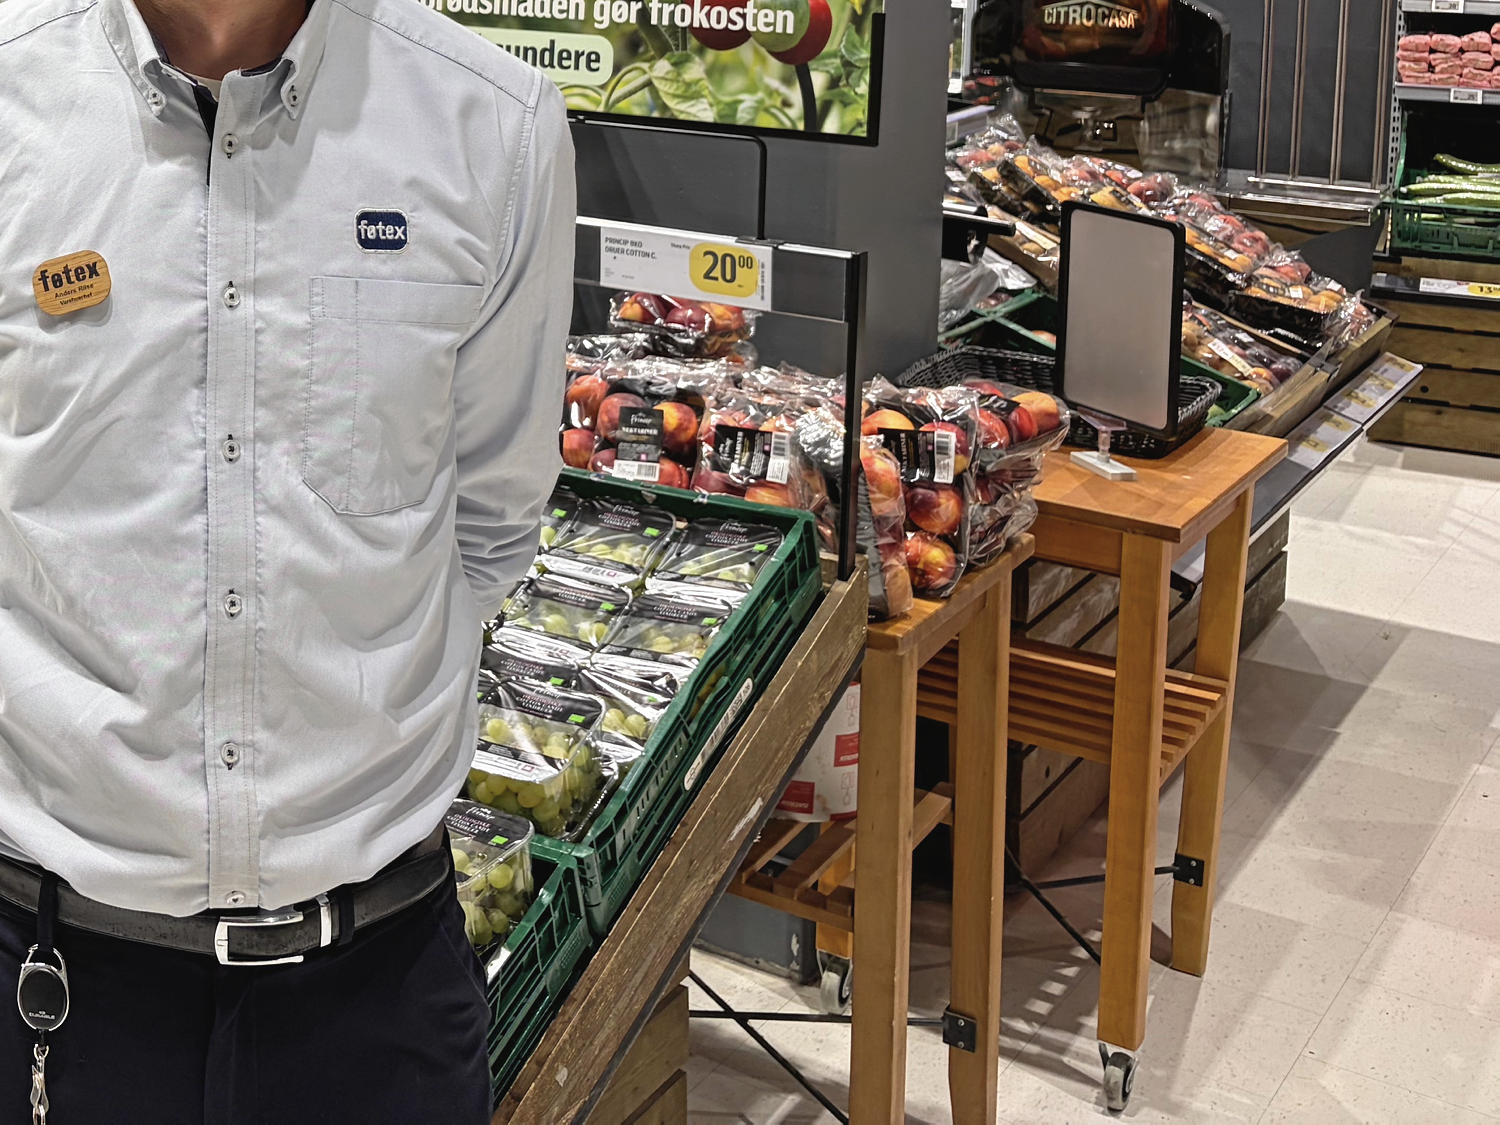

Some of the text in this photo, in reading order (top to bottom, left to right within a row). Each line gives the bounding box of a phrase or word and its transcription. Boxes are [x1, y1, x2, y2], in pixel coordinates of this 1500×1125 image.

[593, 0, 642, 29] gør
[1043, 3, 1136, 29] CITROCASA
[496, 39, 601, 72] undere
[357, 219, 406, 240] føtex
[604, 236, 629, 247] PRINCIP
[604, 245, 625, 255] DRUER
[625, 248, 650, 259] COTTON
[38, 261, 101, 293] føtex
